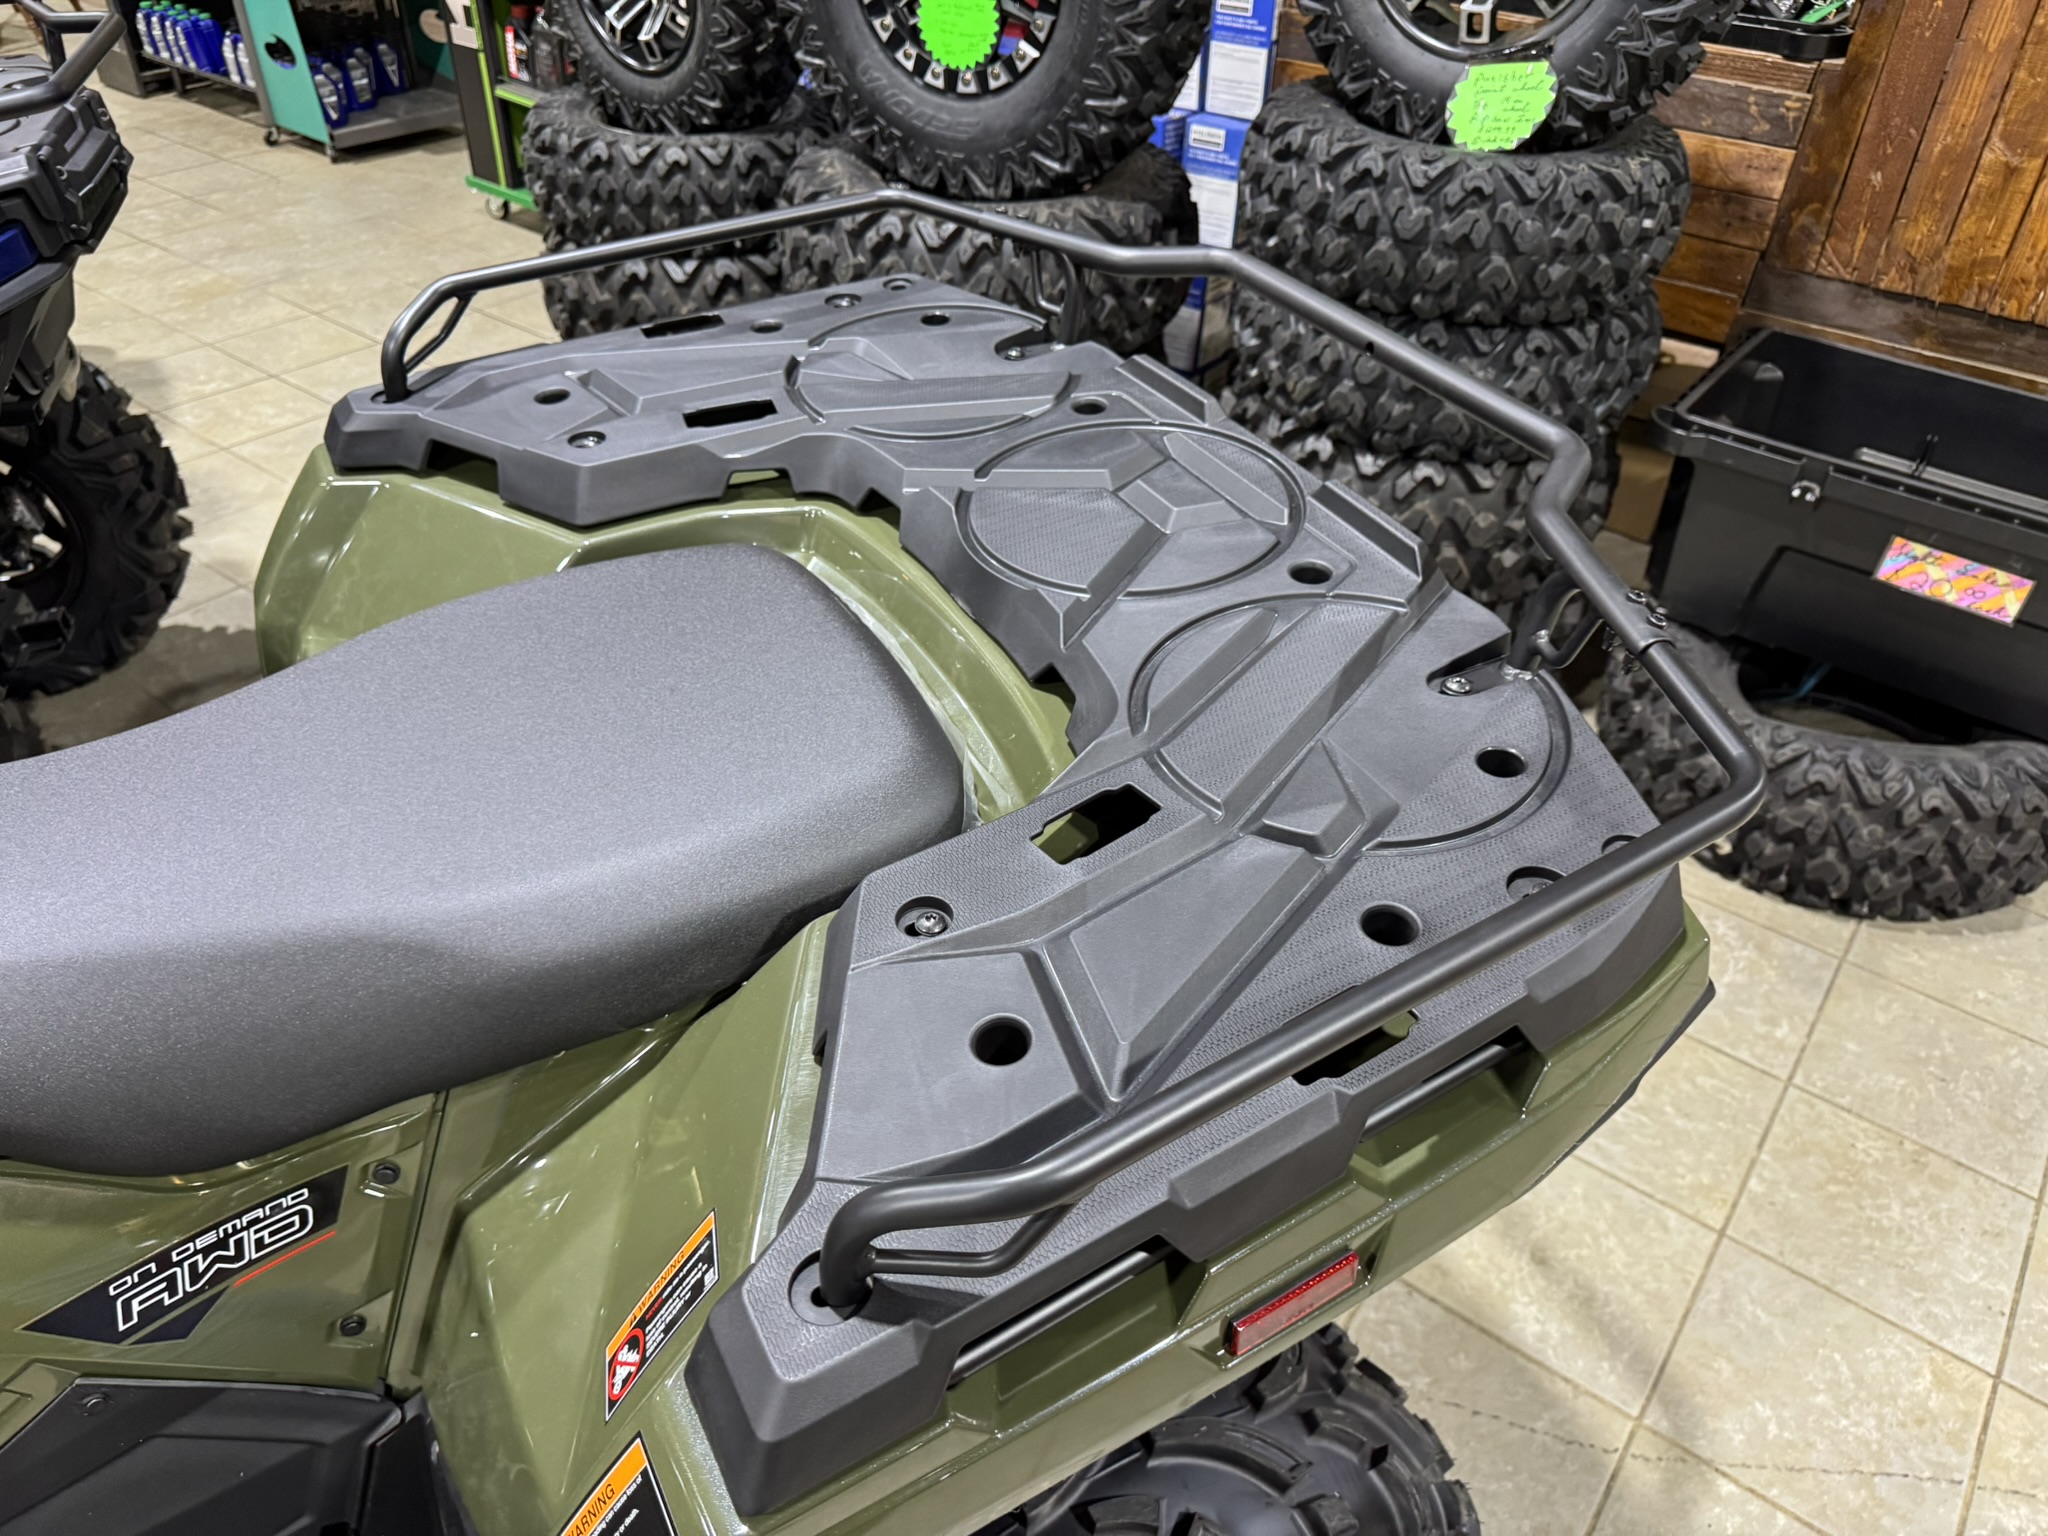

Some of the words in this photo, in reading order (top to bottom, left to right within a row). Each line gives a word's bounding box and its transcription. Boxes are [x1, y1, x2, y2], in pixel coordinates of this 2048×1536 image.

[108, 1262, 157, 1296] ON
[171, 1187, 310, 1263] DEMAND
[116, 1203, 315, 1332] AWD
[639, 1250, 686, 1313] WARNING
